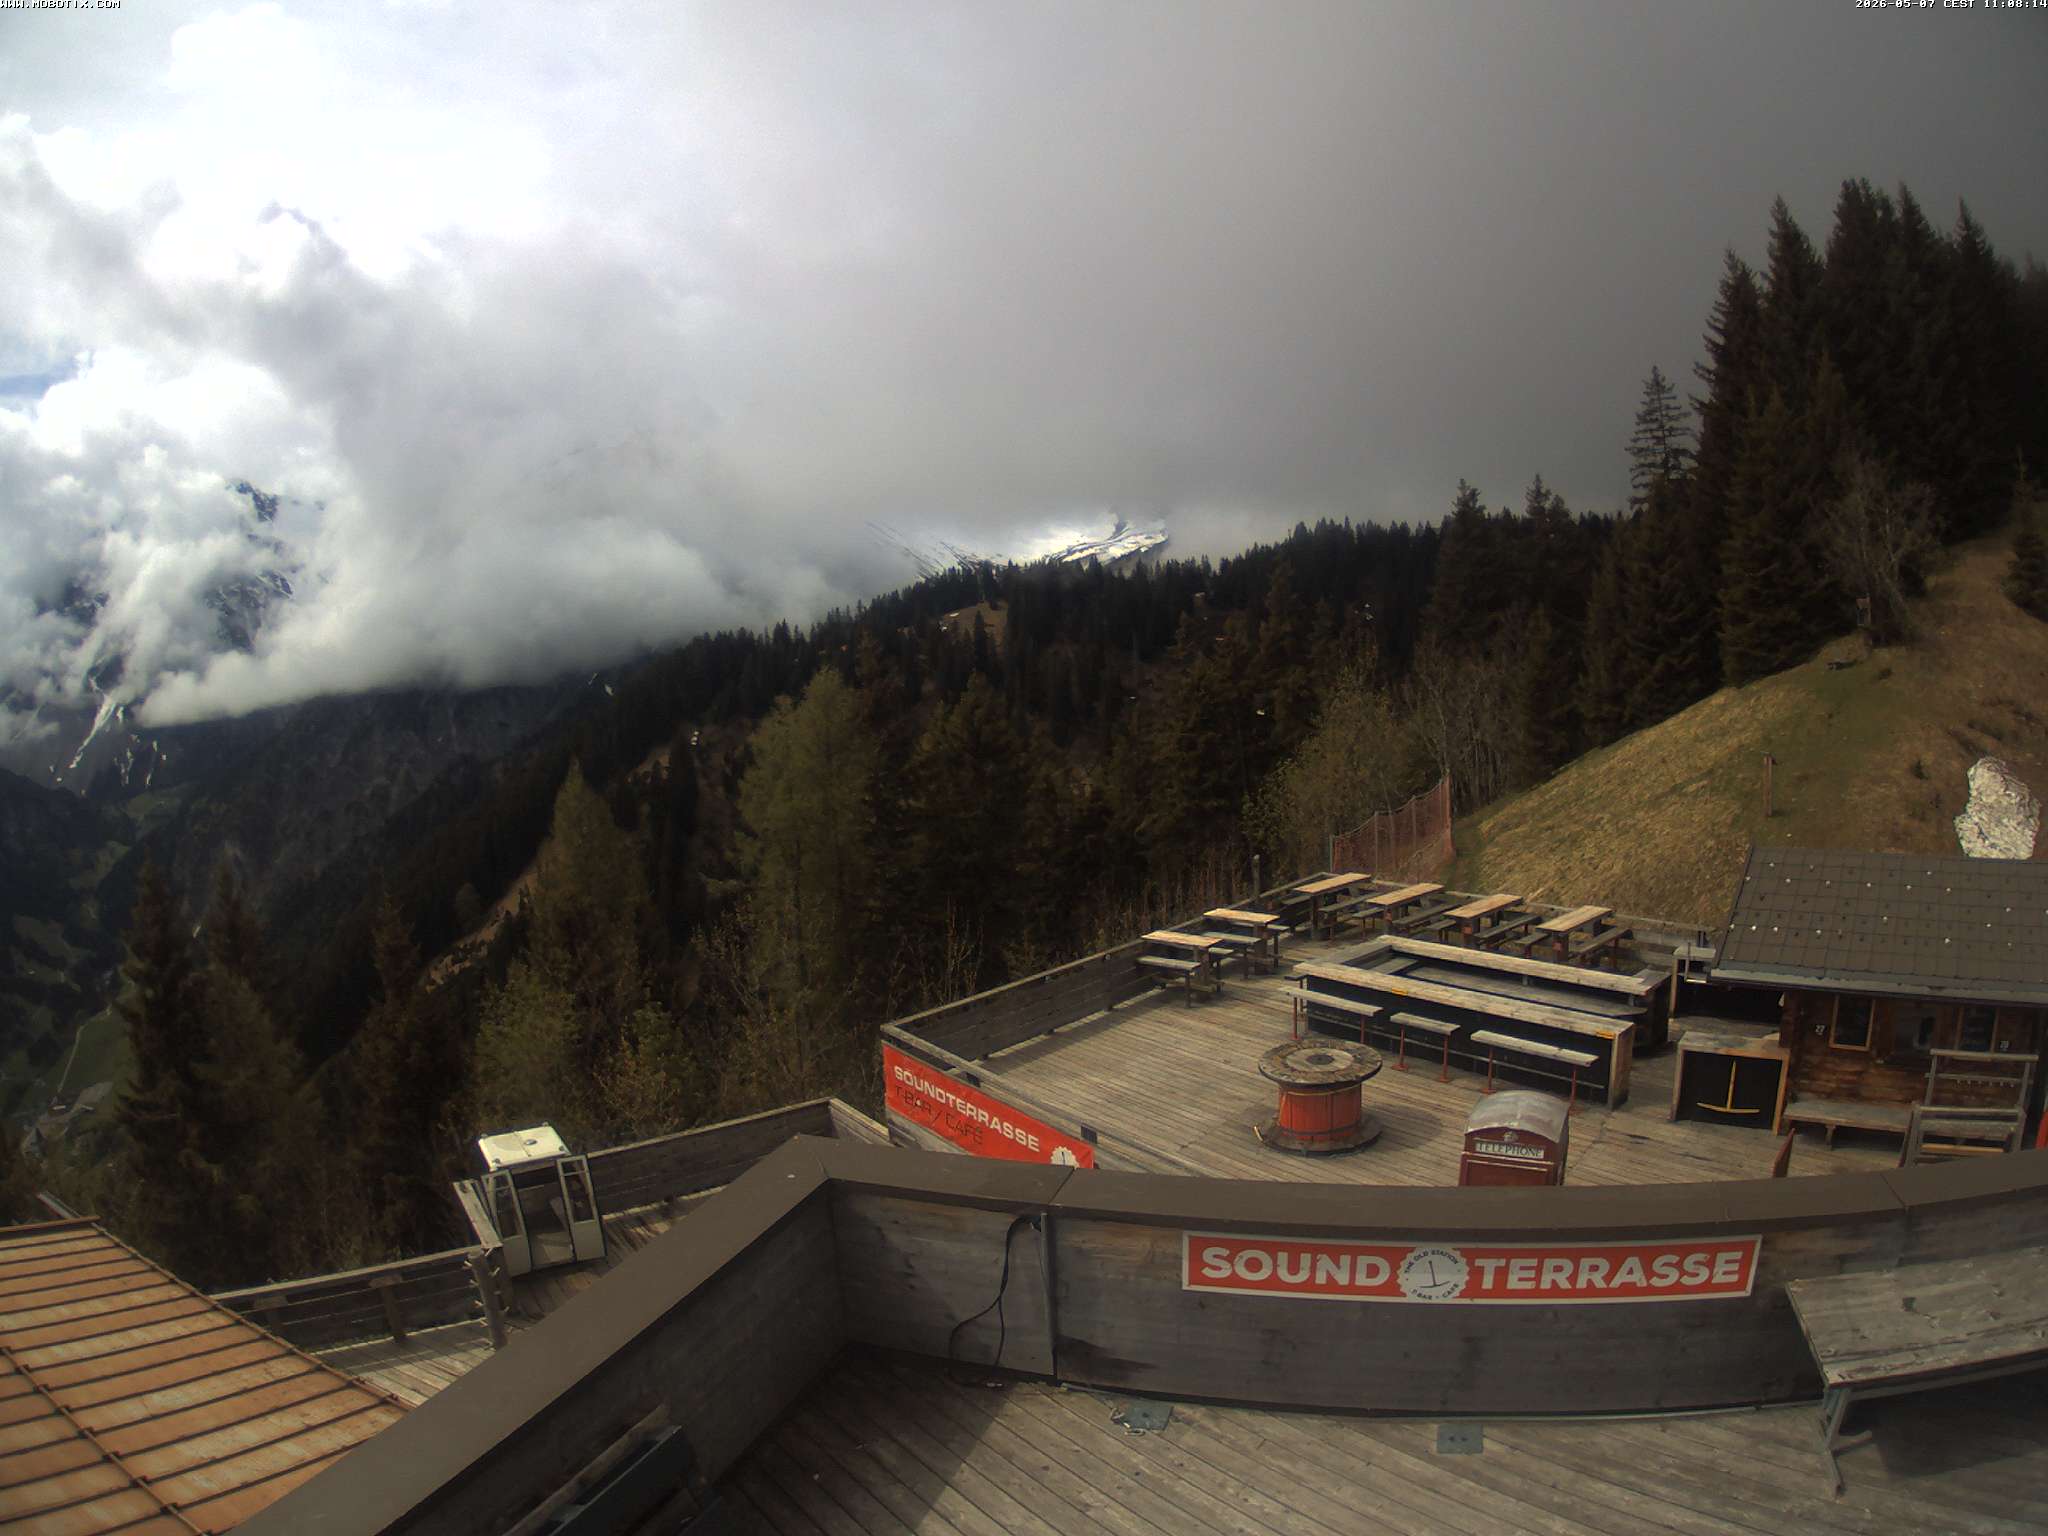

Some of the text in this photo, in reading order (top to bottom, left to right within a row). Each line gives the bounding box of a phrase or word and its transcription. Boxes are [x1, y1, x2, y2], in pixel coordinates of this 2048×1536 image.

[894, 1065, 1040, 1152] SOUNDTERRASSE
[1475, 1142, 1544, 1158] TELEPHONE
[1201, 1246, 1744, 1290] SOUND TERRASSE
